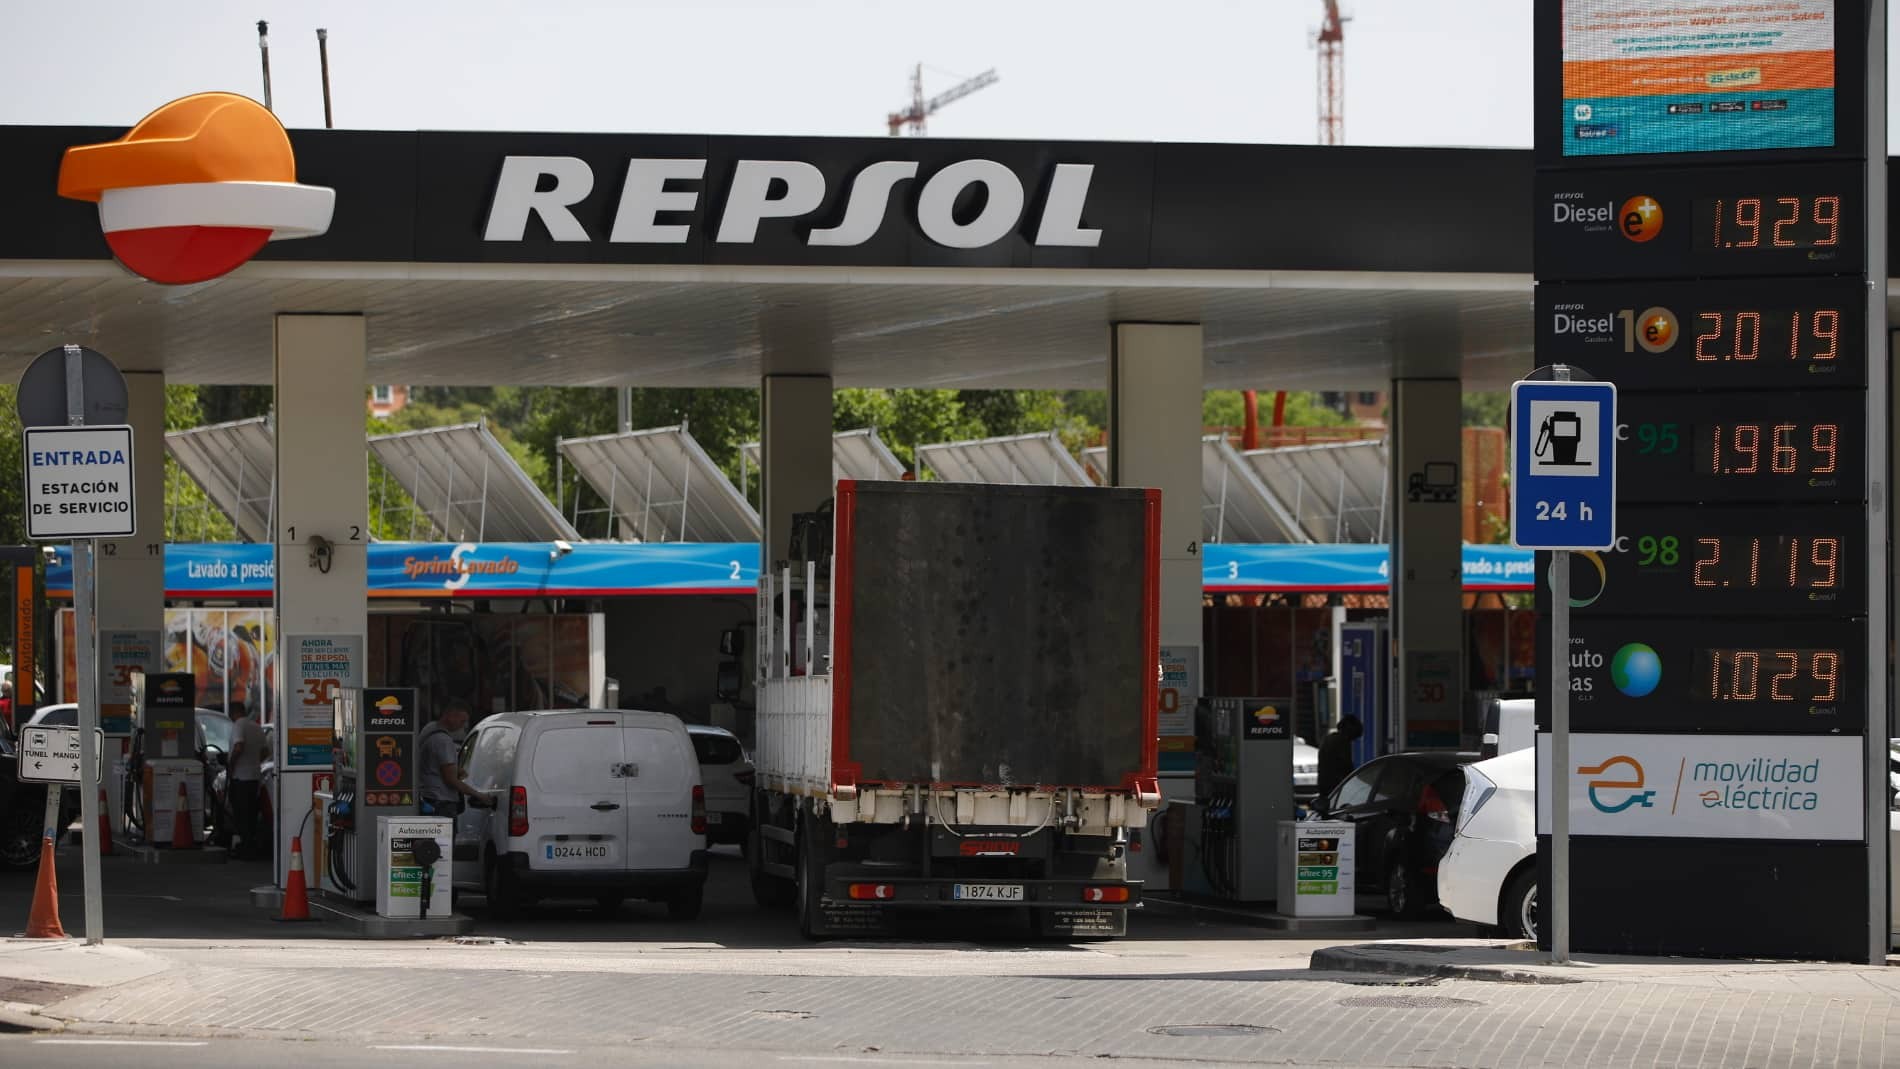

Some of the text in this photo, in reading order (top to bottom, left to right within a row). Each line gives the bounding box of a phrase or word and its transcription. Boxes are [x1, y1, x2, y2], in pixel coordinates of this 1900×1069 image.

[483, 155, 1103, 248] REPSOL
[1554, 201, 1613, 223] Diesel
[1712, 196, 1839, 248] 1.929
[1554, 312, 1613, 334] Diesel
[1696, 310, 1839, 361] 2.019
[1637, 423, 1838, 474] 95 1.969
[33, 450, 125, 467] ENTRADA
[41, 480, 119, 495] ESTACIÓN
[33, 501, 129, 515] DE SERVICIO
[1535, 501, 1593, 521] 24 h
[288, 526, 296, 541] 1
[349, 526, 360, 541] 2
[103, 544, 117, 556] 12
[146, 544, 159, 556] 11
[1186, 542, 1198, 556] 4
[188, 560, 229, 578] Lavado
[231, 565, 238, 578] a
[1377, 560, 1389, 578] 4
[1462, 557, 1493, 574] vado
[1494, 562, 1502, 574] a
[1637, 535, 1838, 587] 98 2.119
[729, 560, 741, 580] 2
[1228, 561, 1239, 579] 3
[20, 598, 33, 673] Autolavado
[302, 639, 332, 647] AHORA
[1568, 649, 1838, 701] uto 1.029
[1568, 677, 1593, 691] as
[25, 750, 49, 758] TUNEL
[53, 751, 80, 759] MANGU
[1693, 758, 1820, 784] movilidad
[1698, 784, 1818, 811] eléctrica
[398, 827, 441, 835] Autoservicio
[393, 841, 412, 849] Diesel
[554, 847, 582, 857] 0244
[1321, 869, 1333, 878] 95
[965, 886, 1021, 899] 1874 KJF
